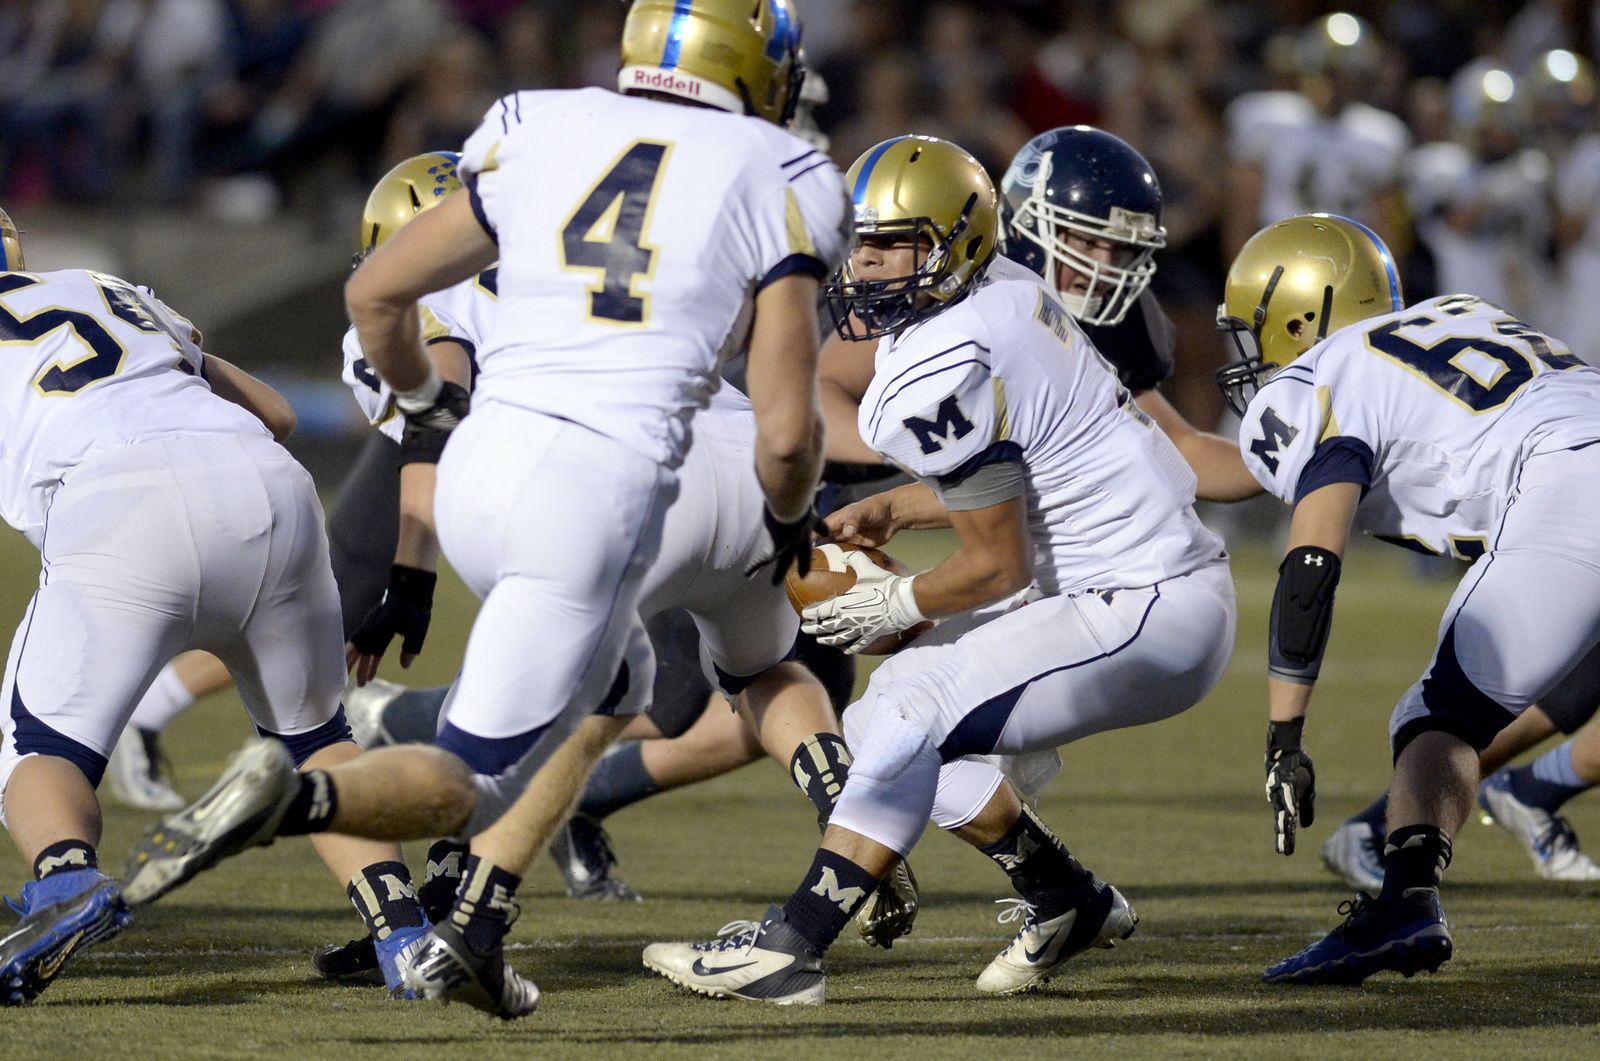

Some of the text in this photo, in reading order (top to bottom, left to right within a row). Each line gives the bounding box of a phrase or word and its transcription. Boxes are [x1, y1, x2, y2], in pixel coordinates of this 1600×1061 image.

[634, 69, 701, 96] Riddell
[558, 138, 676, 328] 4
[902, 394, 975, 455] M
[1250, 405, 1300, 476] M
[38, 848, 88, 880] M
[425, 851, 463, 884] M
[379, 873, 420, 904] M
[811, 866, 866, 913] M
